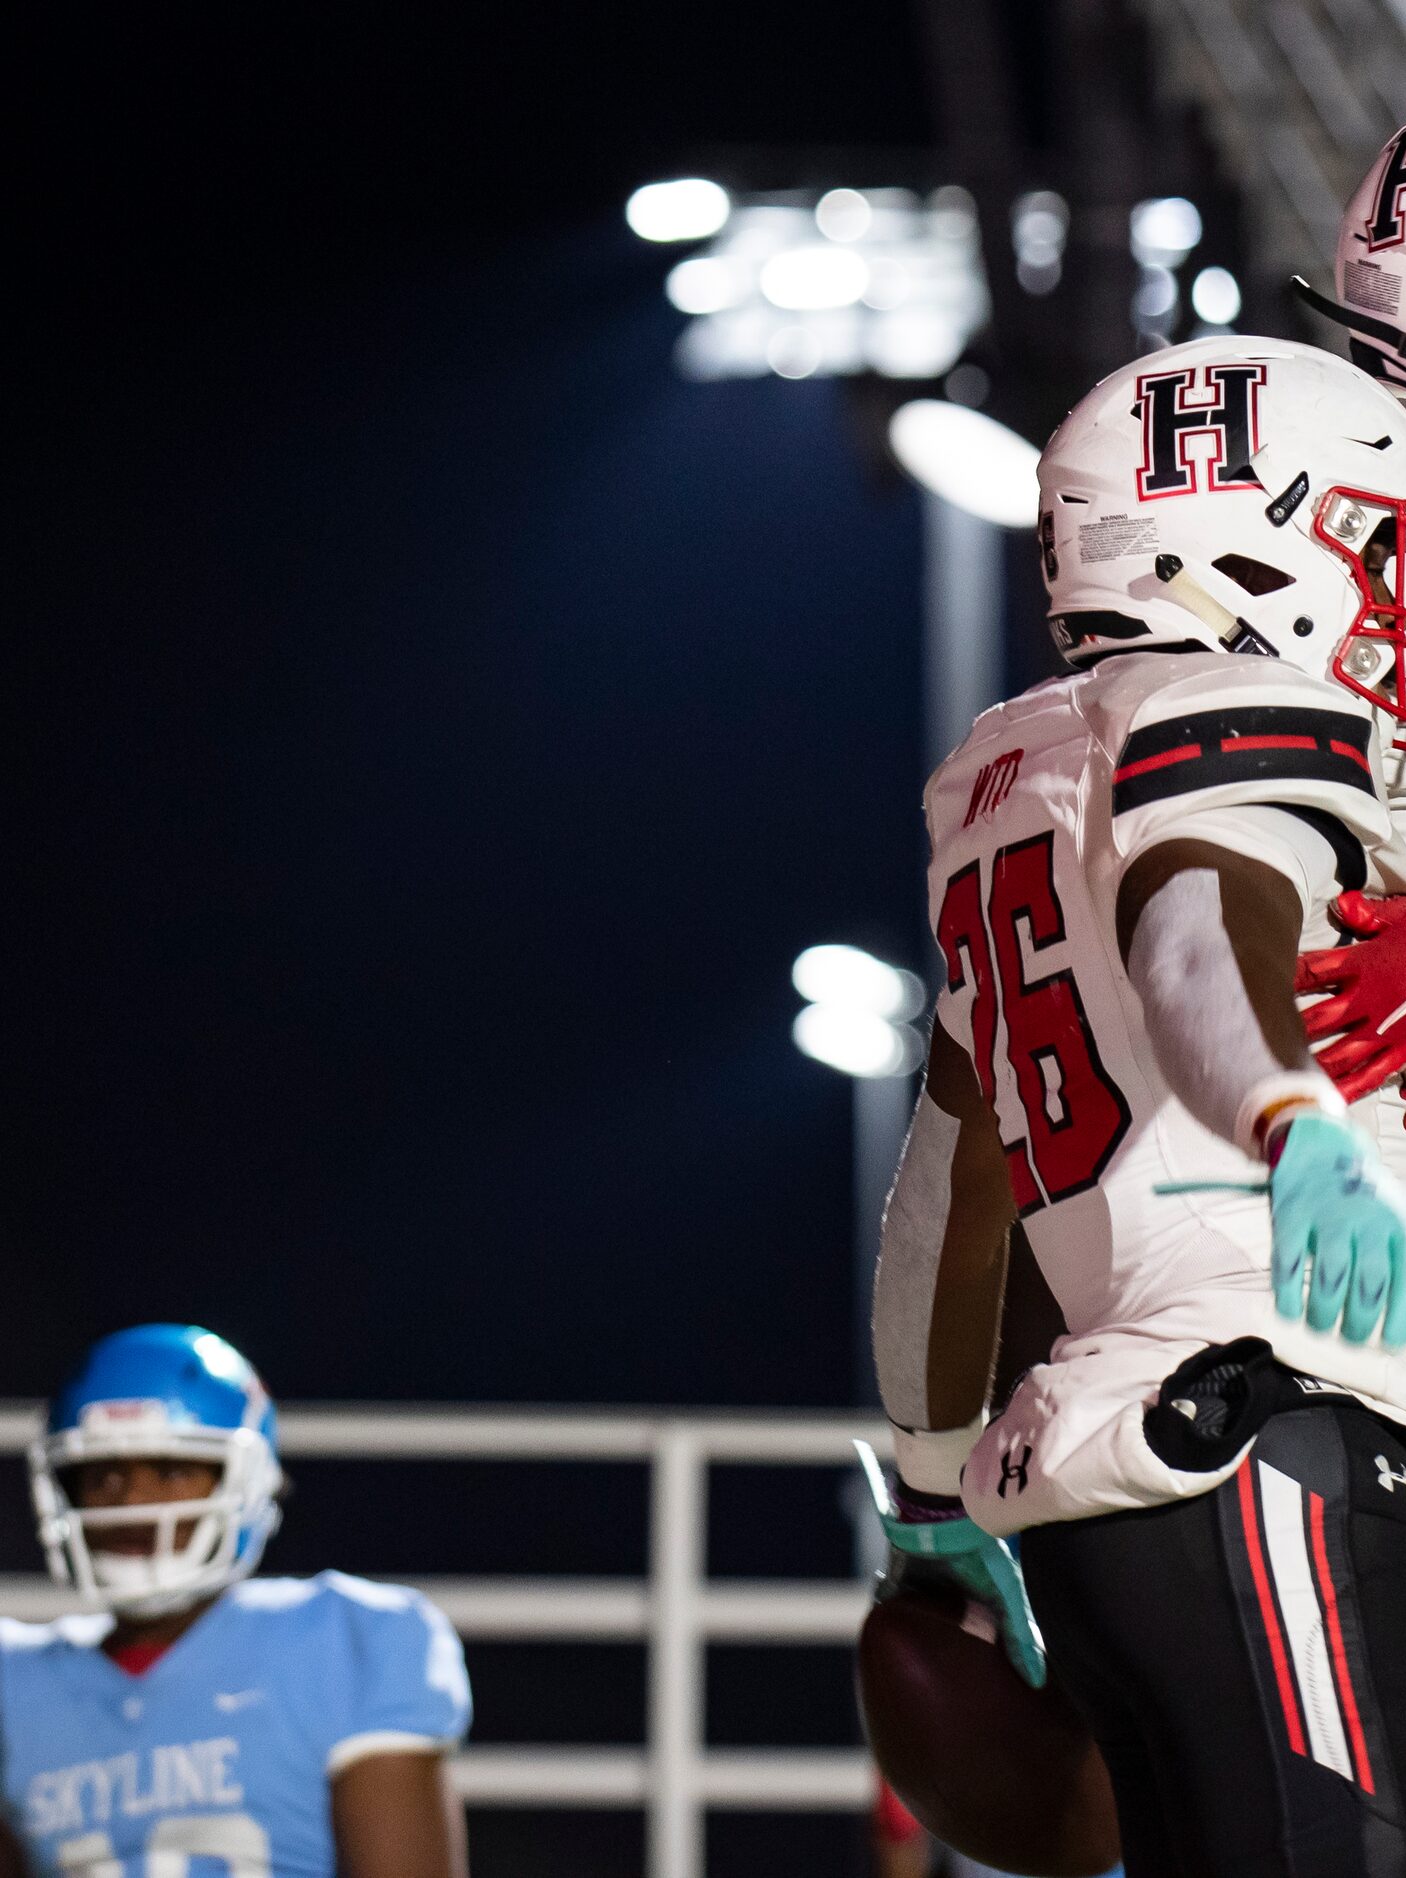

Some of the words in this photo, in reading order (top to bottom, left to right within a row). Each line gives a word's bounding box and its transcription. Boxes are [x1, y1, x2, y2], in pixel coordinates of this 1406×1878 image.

[1136, 363, 1268, 503] H
[936, 829, 1133, 1219] 26
[27, 1736, 245, 1835] SKYLINE
